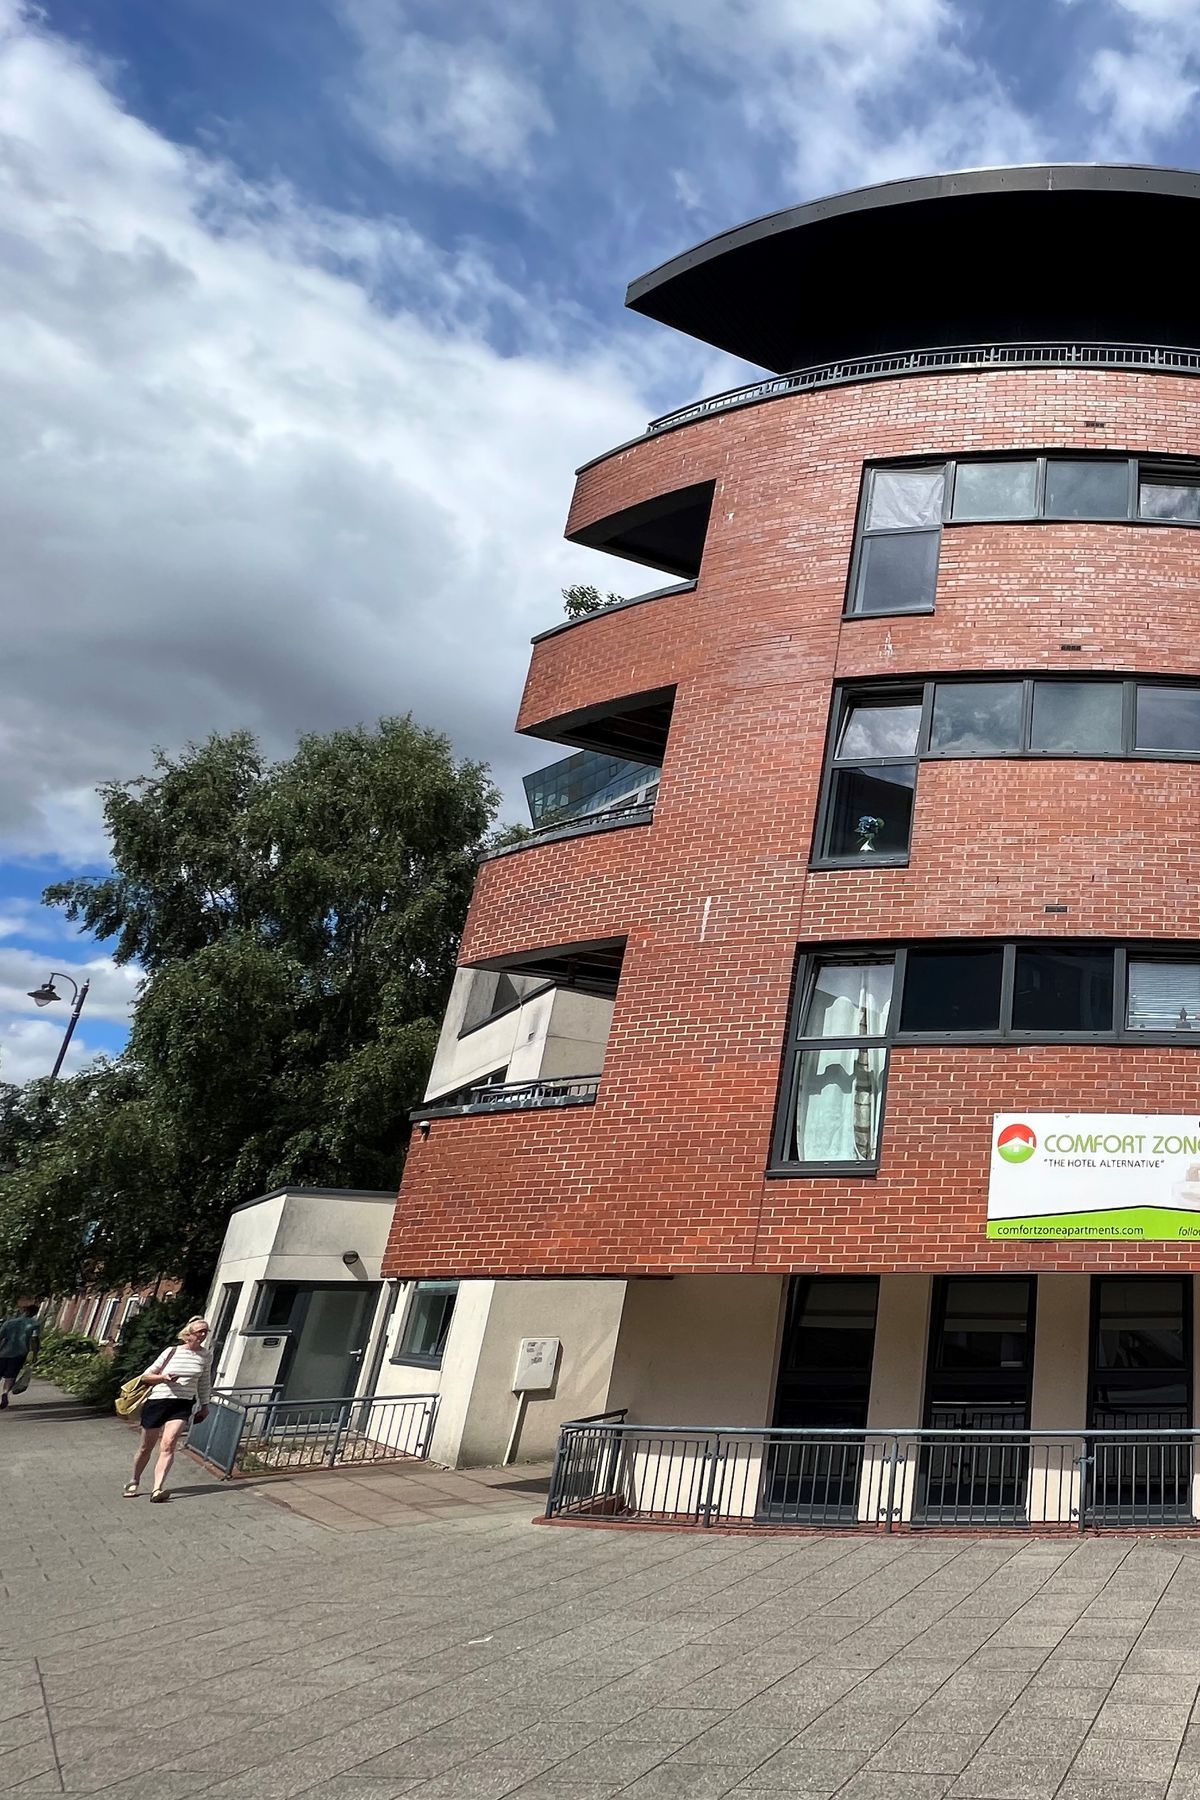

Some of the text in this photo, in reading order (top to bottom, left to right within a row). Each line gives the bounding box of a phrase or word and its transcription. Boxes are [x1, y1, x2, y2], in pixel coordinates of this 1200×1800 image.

[1044, 1134, 1147, 1154] COMFORT
[1067, 1159, 1097, 1168] HOTEL
[997, 1224, 1144, 1237] comfortzoneapartments.com
